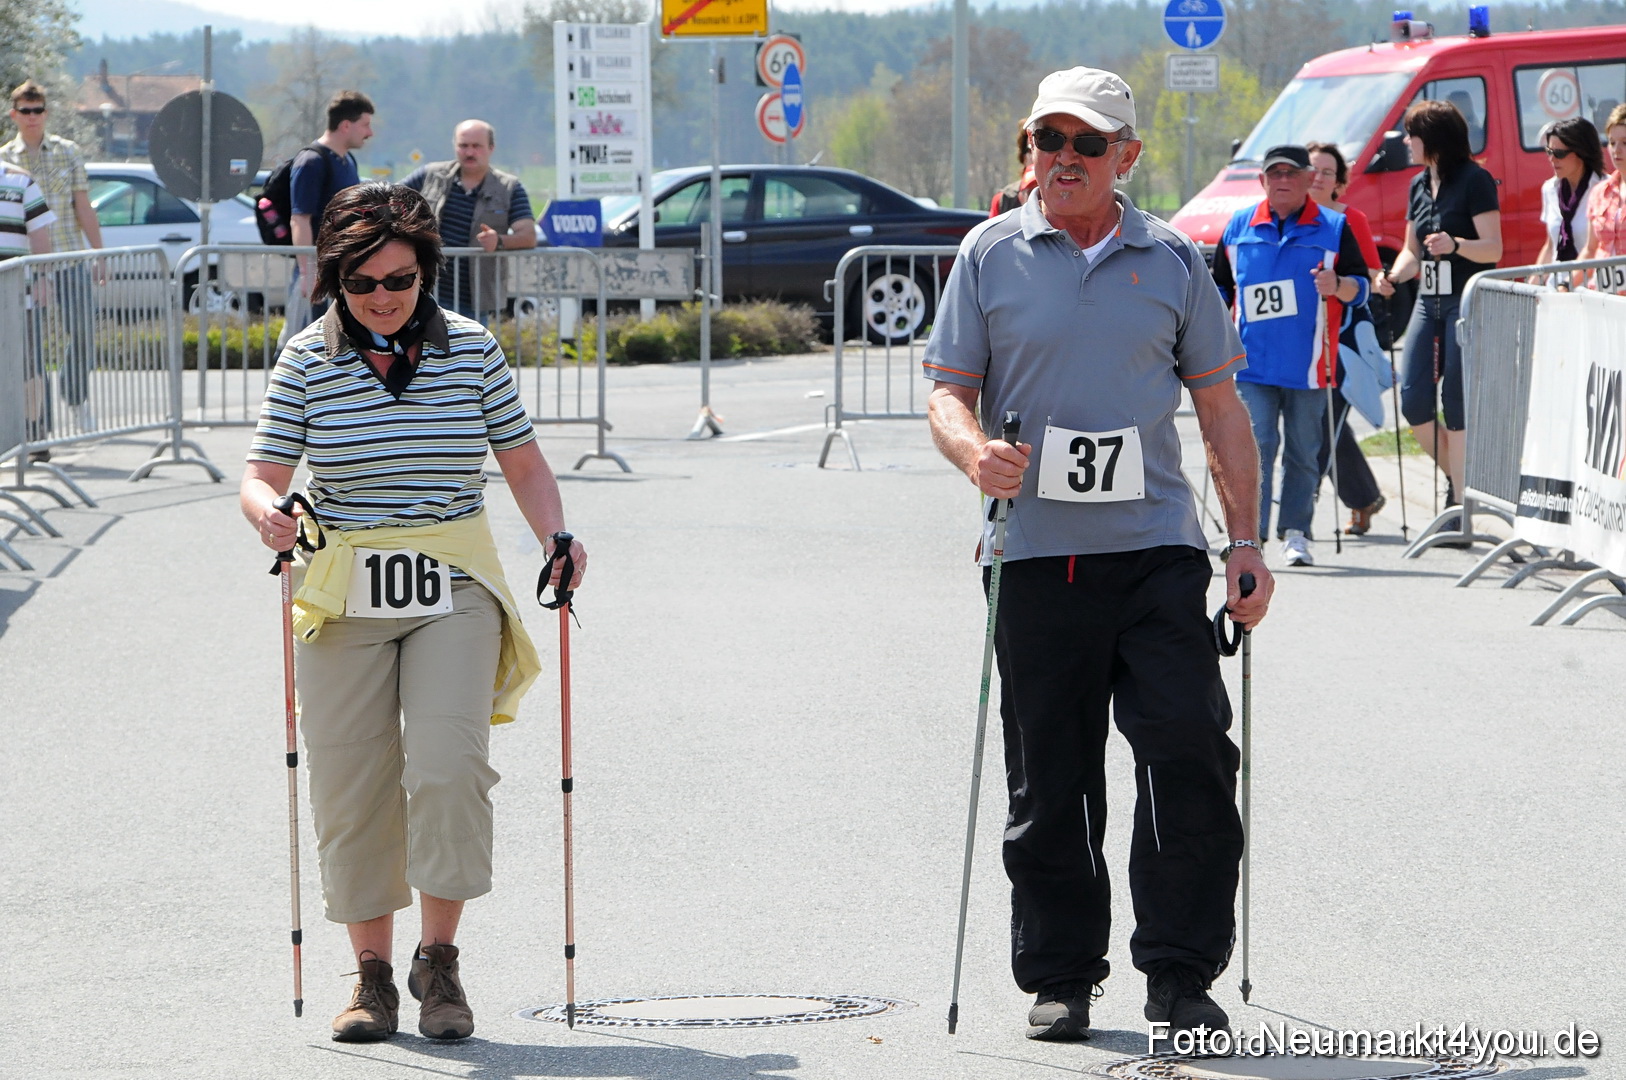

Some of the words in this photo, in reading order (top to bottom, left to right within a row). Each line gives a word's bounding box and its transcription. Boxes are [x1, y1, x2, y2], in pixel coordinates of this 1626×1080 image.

[1549, 83, 1573, 105] 60
[551, 214, 597, 234] VOLVO
[1254, 285, 1283, 315] 29
[1067, 435, 1124, 493] 37
[365, 552, 441, 609] 106
